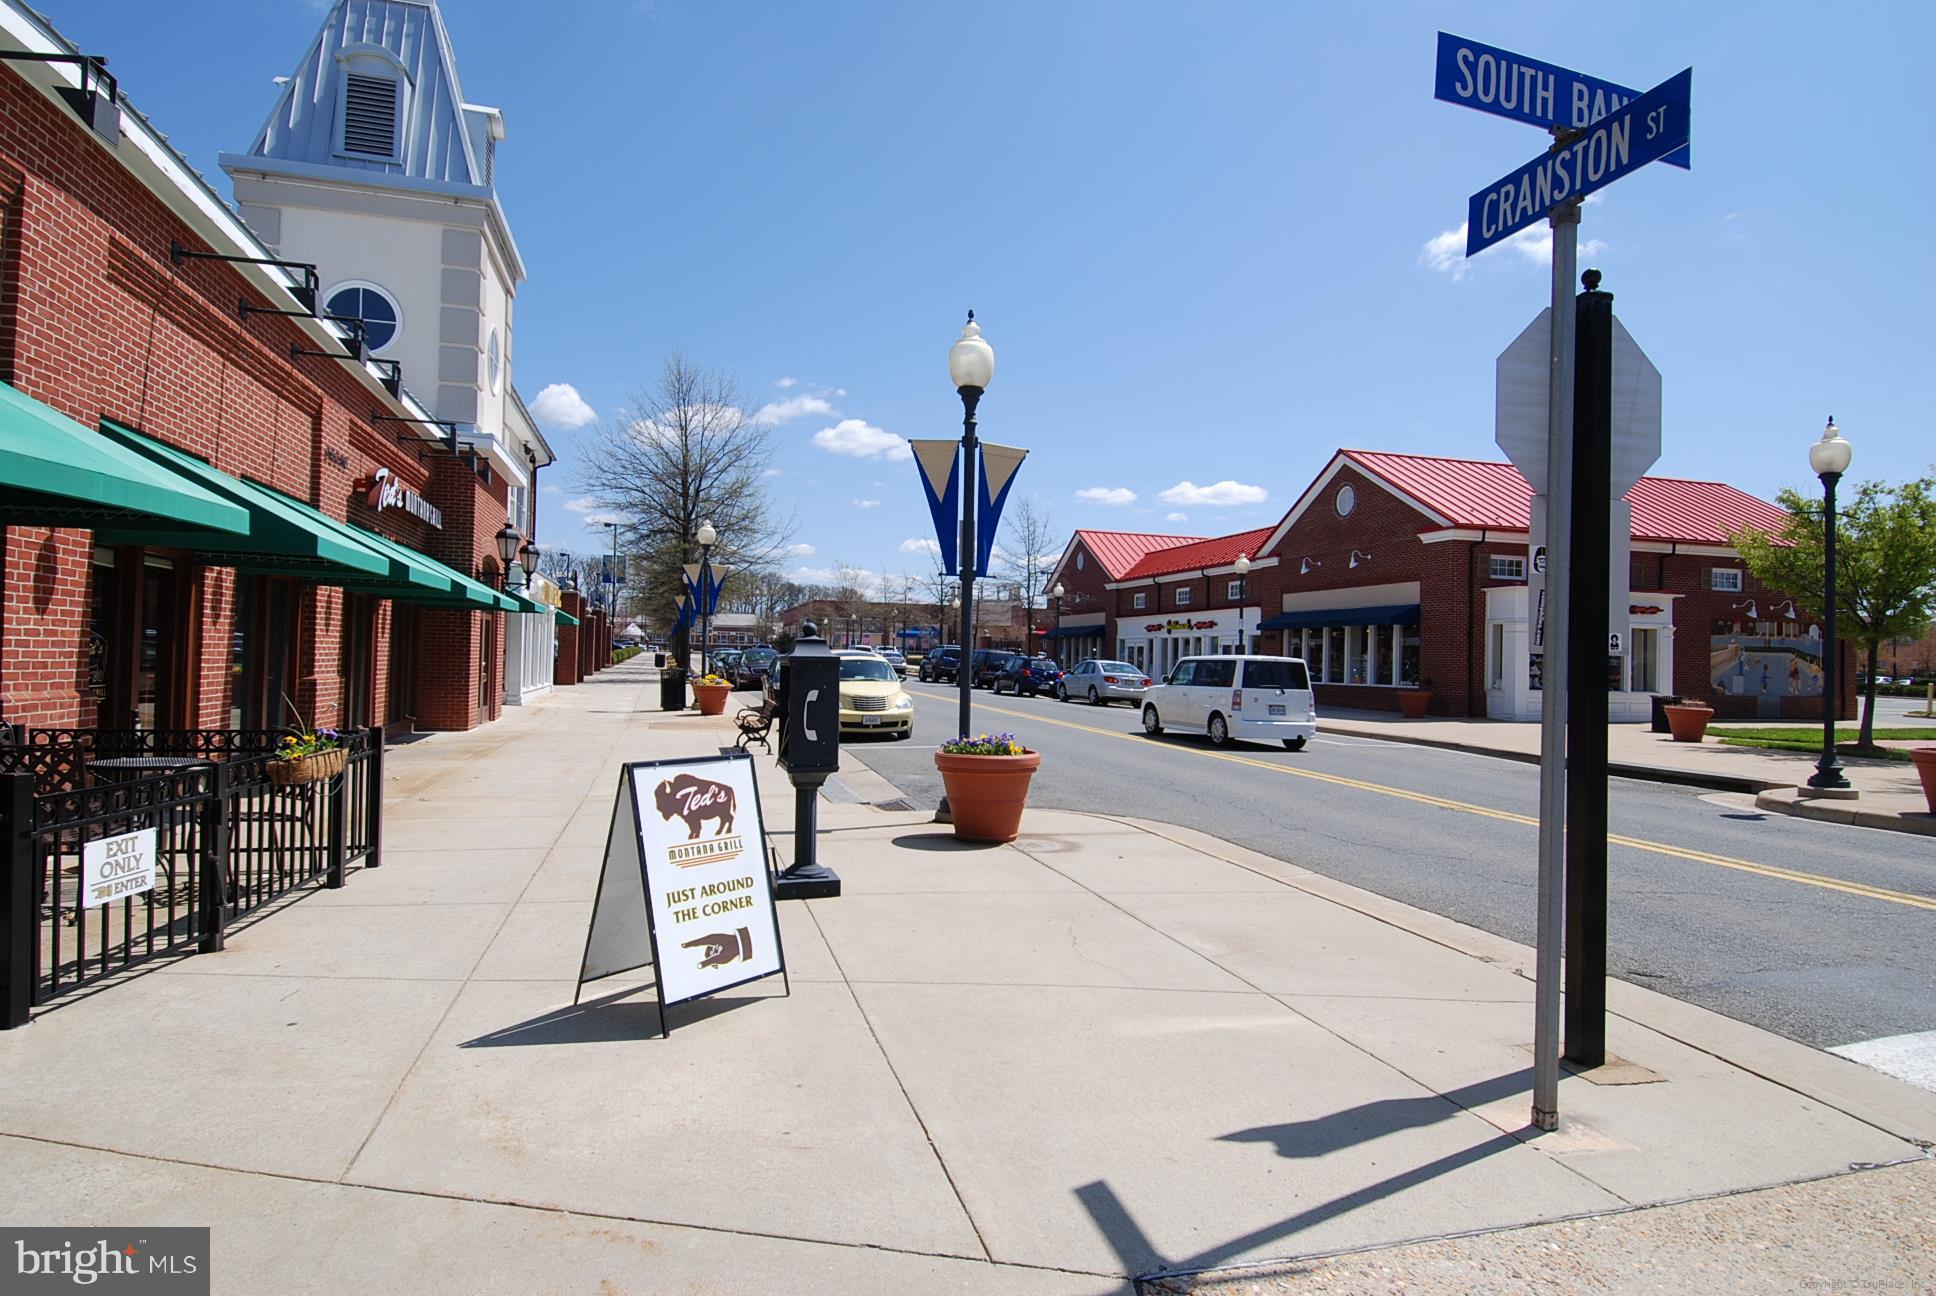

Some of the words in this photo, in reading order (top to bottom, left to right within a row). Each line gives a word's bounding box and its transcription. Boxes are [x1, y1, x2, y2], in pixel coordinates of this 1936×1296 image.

[1455, 48, 1555, 120] SOUTH
[1572, 81, 1630, 129] BA
[1482, 114, 1631, 239] CRANSTON
[1646, 105, 1668, 140] ST
[675, 784, 728, 816] Ted's
[106, 836, 138, 858] EXIT
[668, 844, 715, 861] MONTANA
[717, 839, 744, 852] GRILL
[100, 853, 143, 879] ONLY
[114, 875, 148, 894] ENTER
[666, 887, 696, 908] JUST
[700, 876, 754, 899] AROUND
[673, 906, 699, 924] THE
[702, 895, 754, 917] CORNER
